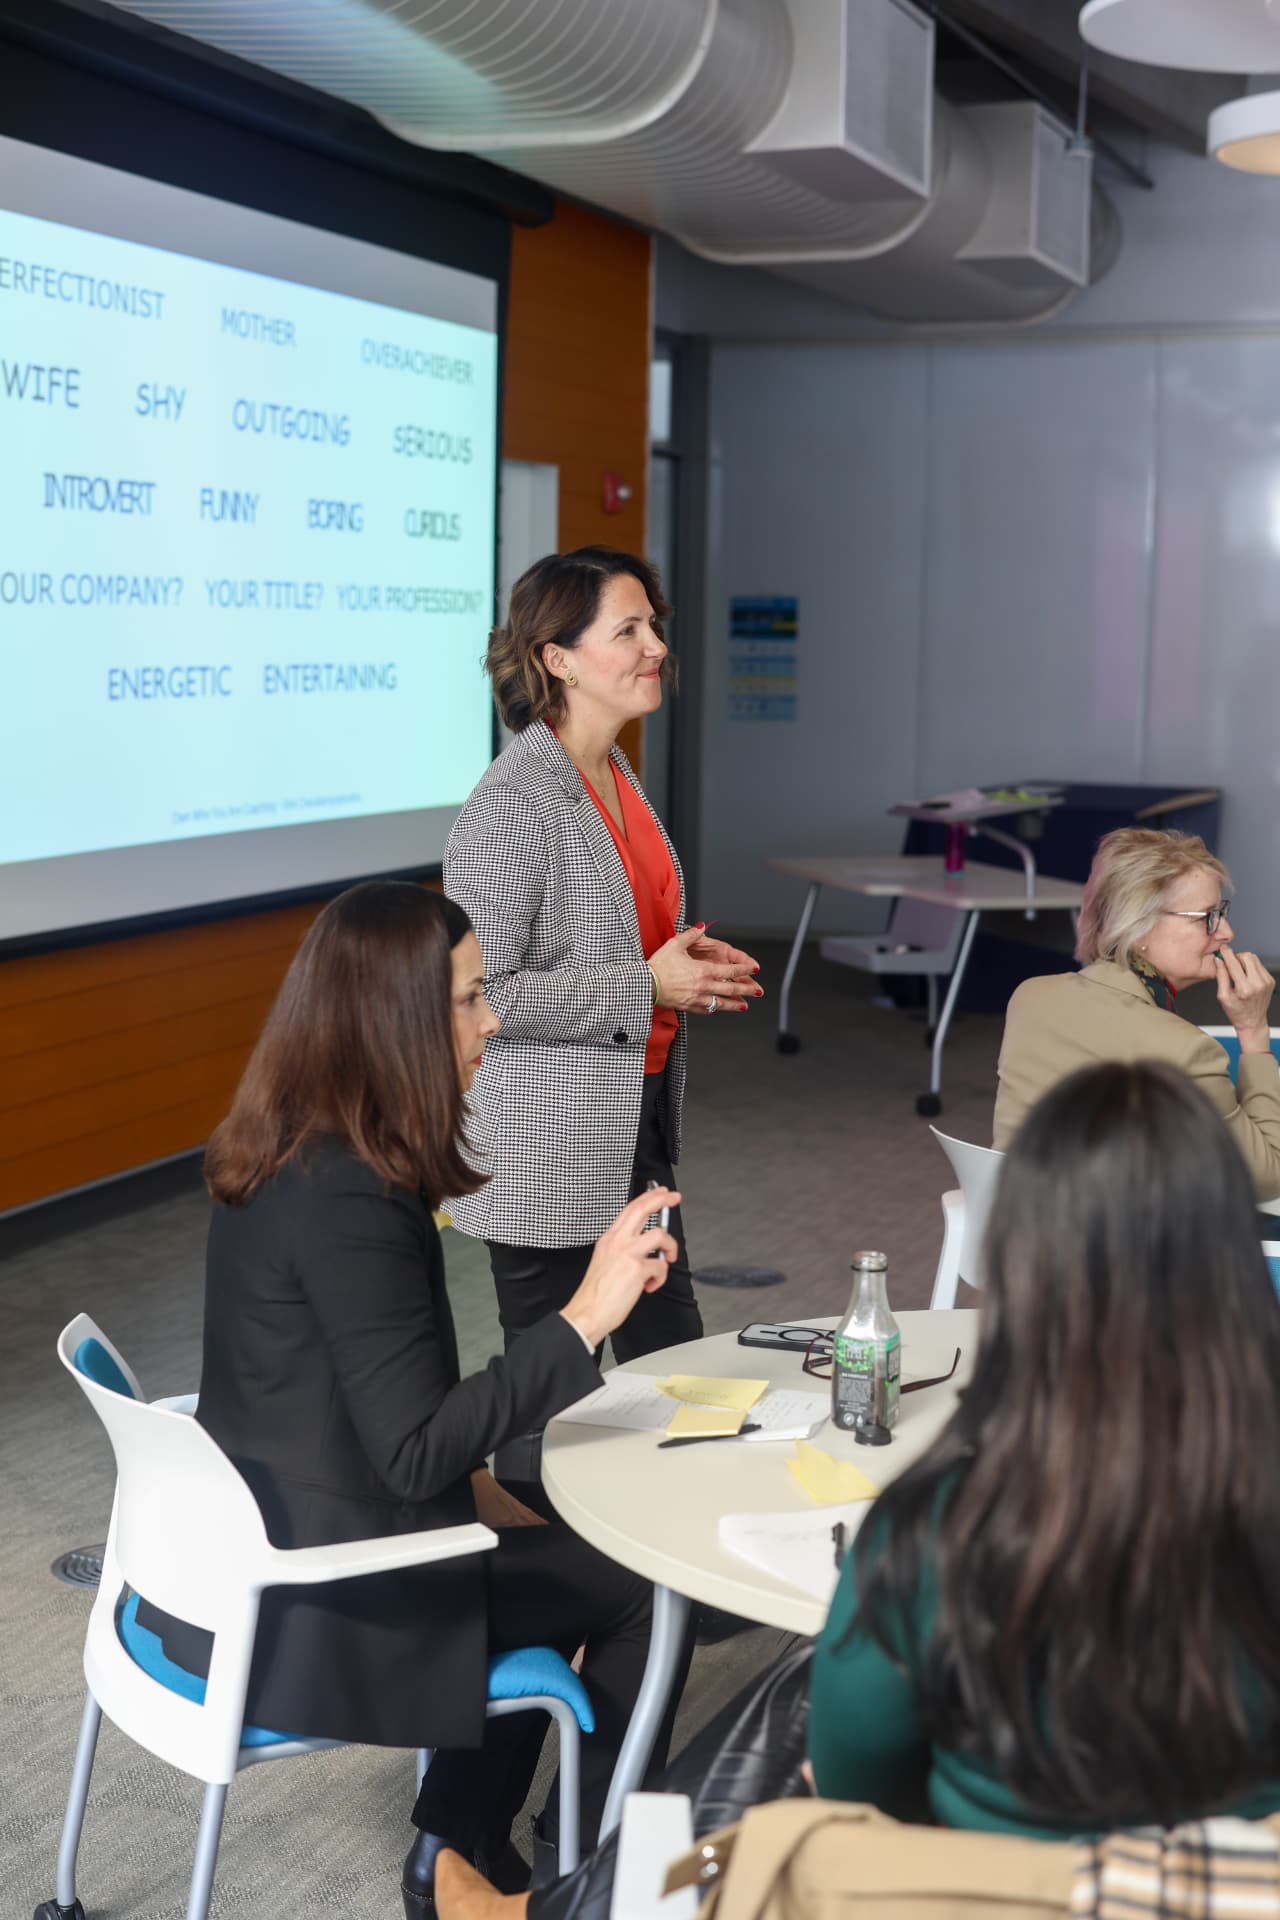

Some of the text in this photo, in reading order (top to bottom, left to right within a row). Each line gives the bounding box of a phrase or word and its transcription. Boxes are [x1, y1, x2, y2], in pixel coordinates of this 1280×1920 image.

[0, 257, 165, 320] ERFECTIONIST
[221, 307, 296, 346] MOTHER
[361, 338, 474, 385] OVERACHIEVER
[1, 360, 80, 409] WIFE
[136, 383, 186, 420] SHY
[232, 398, 351, 447] OUTGOING
[393, 424, 471, 464] SERIOUS
[44, 473, 156, 514] INTROVERT
[200, 488, 259, 522] FUNNY
[308, 498, 363, 533] BORING
[405, 508, 460, 541] CURIOUS
[60, 573, 183, 605] COMPANY?
[206, 579, 324, 609] YOUR TITLE?
[337, 584, 381, 611] YOUR
[108, 665, 232, 701] ENERGETIC
[264, 662, 397, 694] ENTERTAINING
